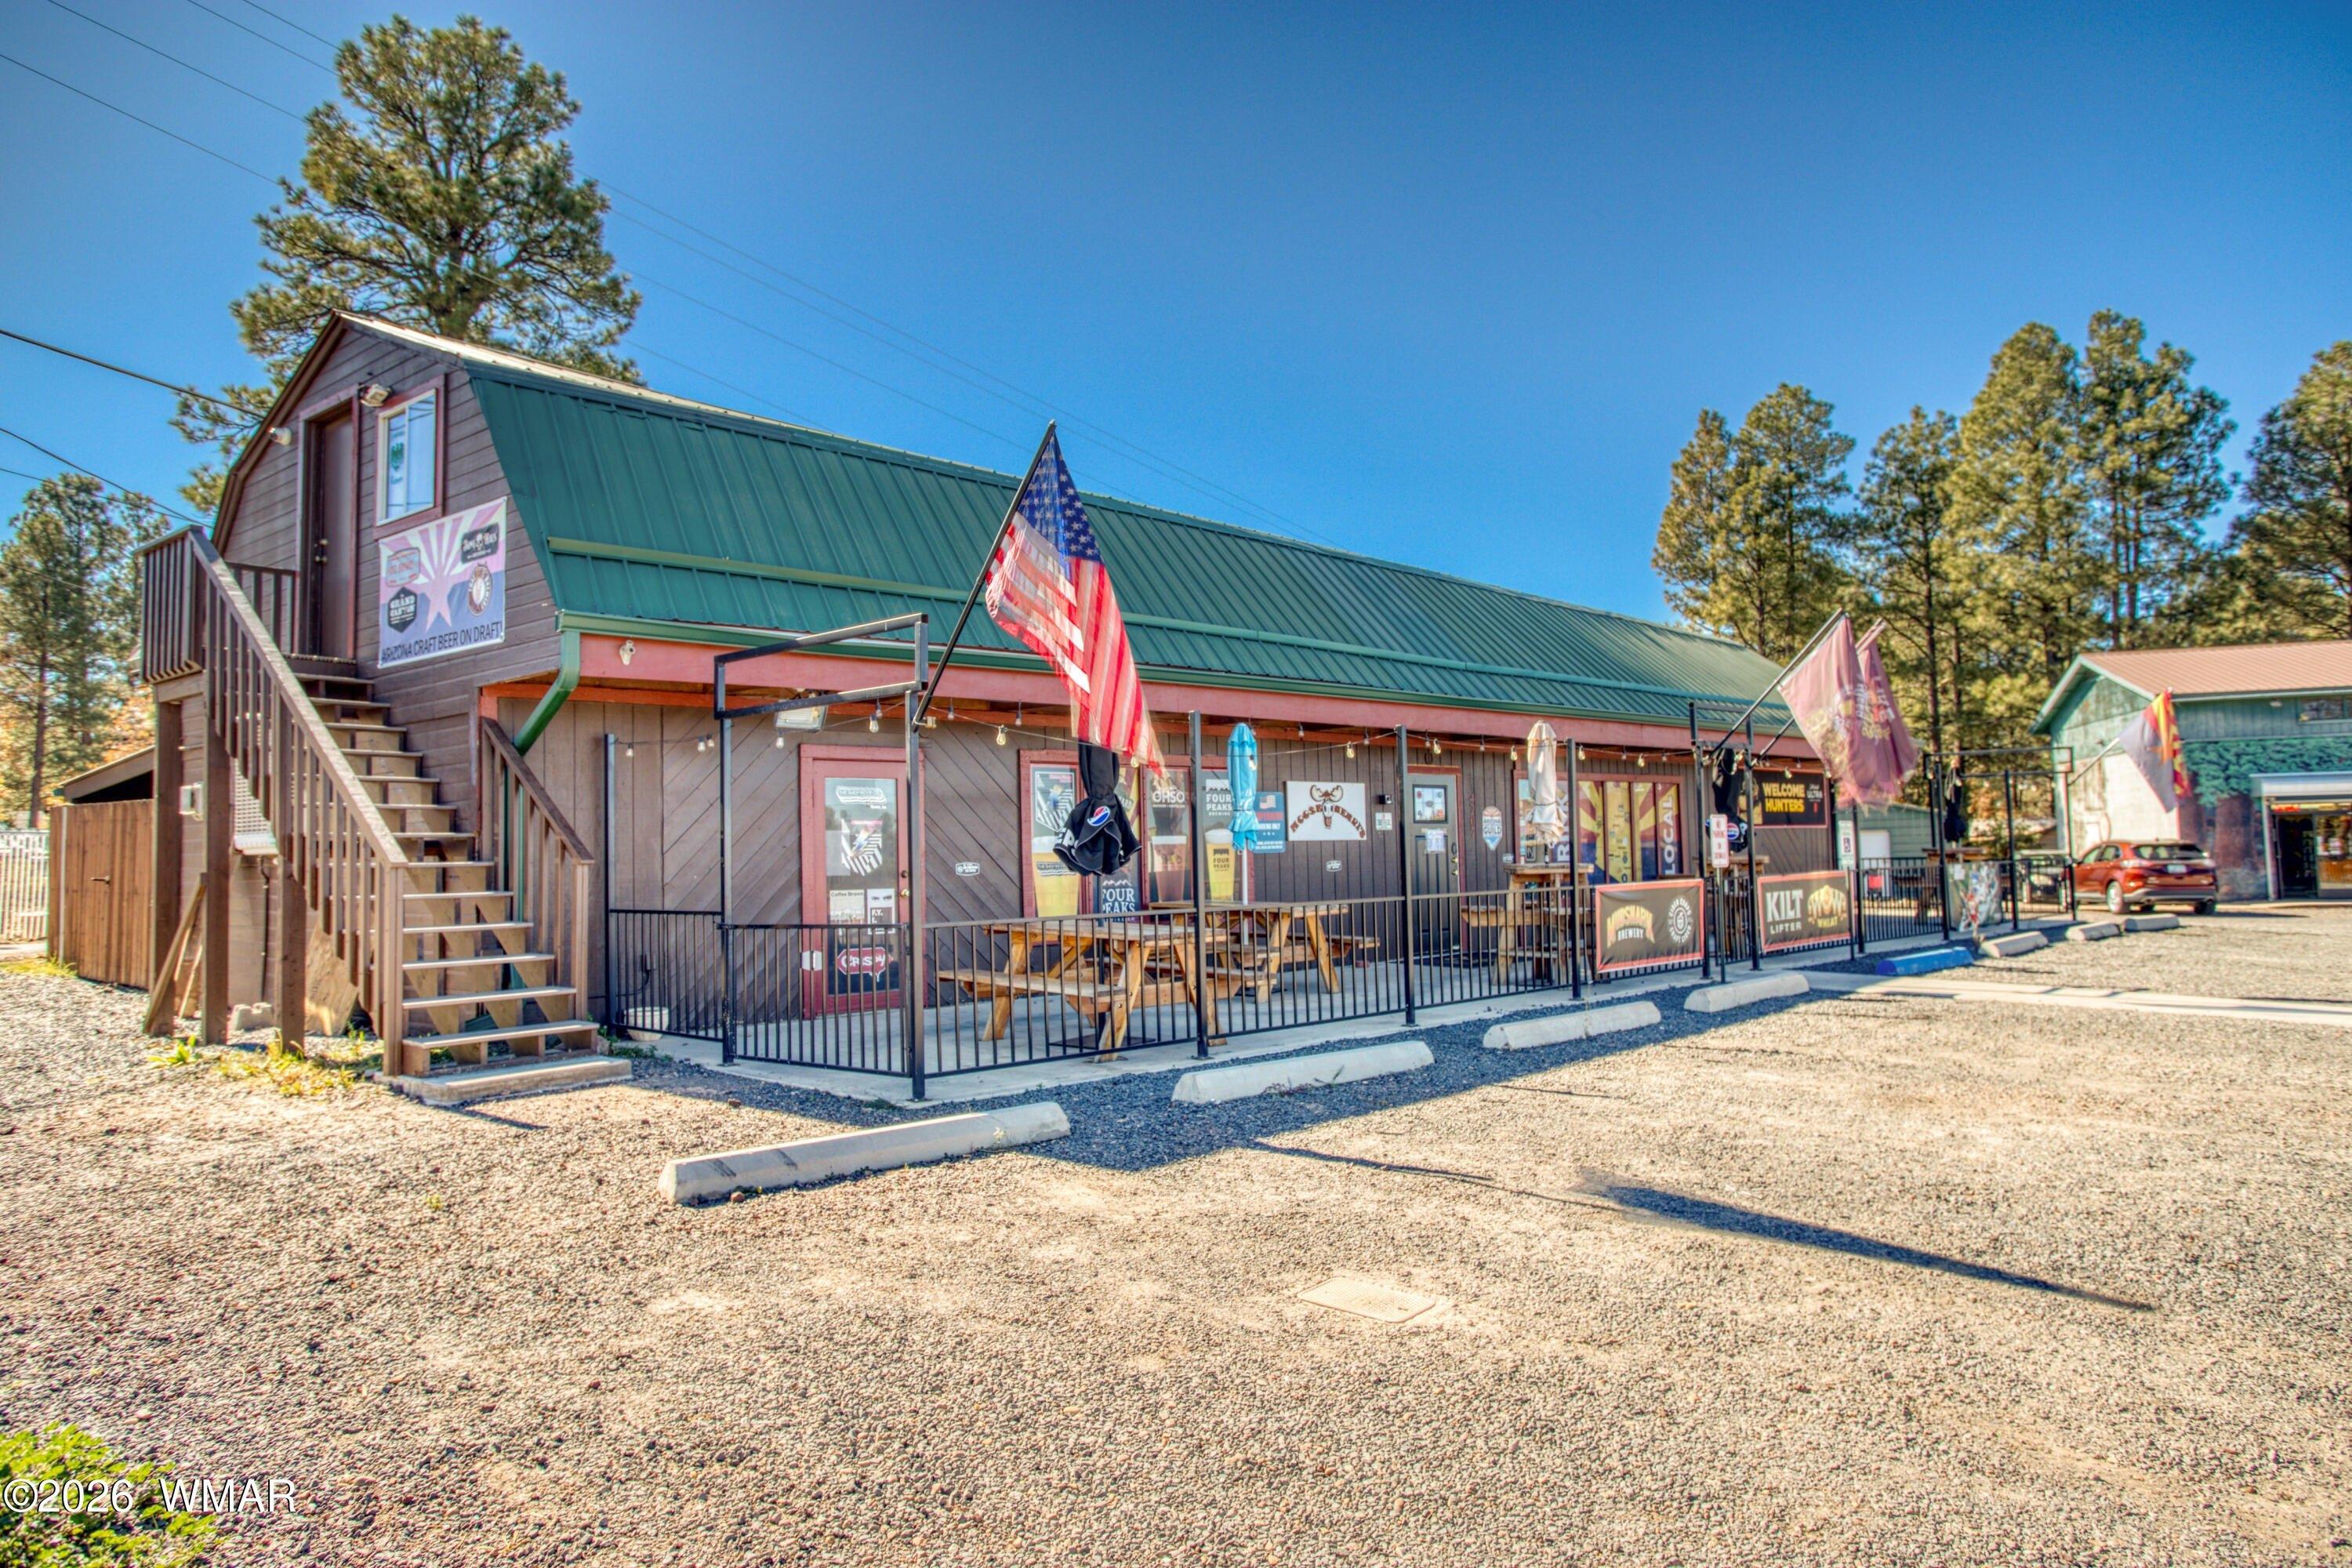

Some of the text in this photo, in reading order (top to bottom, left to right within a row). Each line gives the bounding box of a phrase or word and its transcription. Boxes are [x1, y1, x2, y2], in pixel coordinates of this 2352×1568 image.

[382, 644, 412, 662] ARIZONA
[414, 637, 437, 655] CRAFT
[438, 632, 458, 650] BEER
[460, 628, 471, 644] ON
[1206, 793, 1232, 803] FOUR
[1762, 782, 1806, 798] WELCOME
[1206, 803, 1232, 811] PEAKS
[1766, 797, 1806, 814] HUNTERS
[1290, 804, 1323, 833] MOOSE
[1662, 795, 1676, 876] LOCAL
[1766, 888, 1803, 923] KILT
[1617, 927, 1644, 942] BREWERY
[1769, 921, 1802, 935] LIFTER
[840, 953, 886, 967] CRSPY
